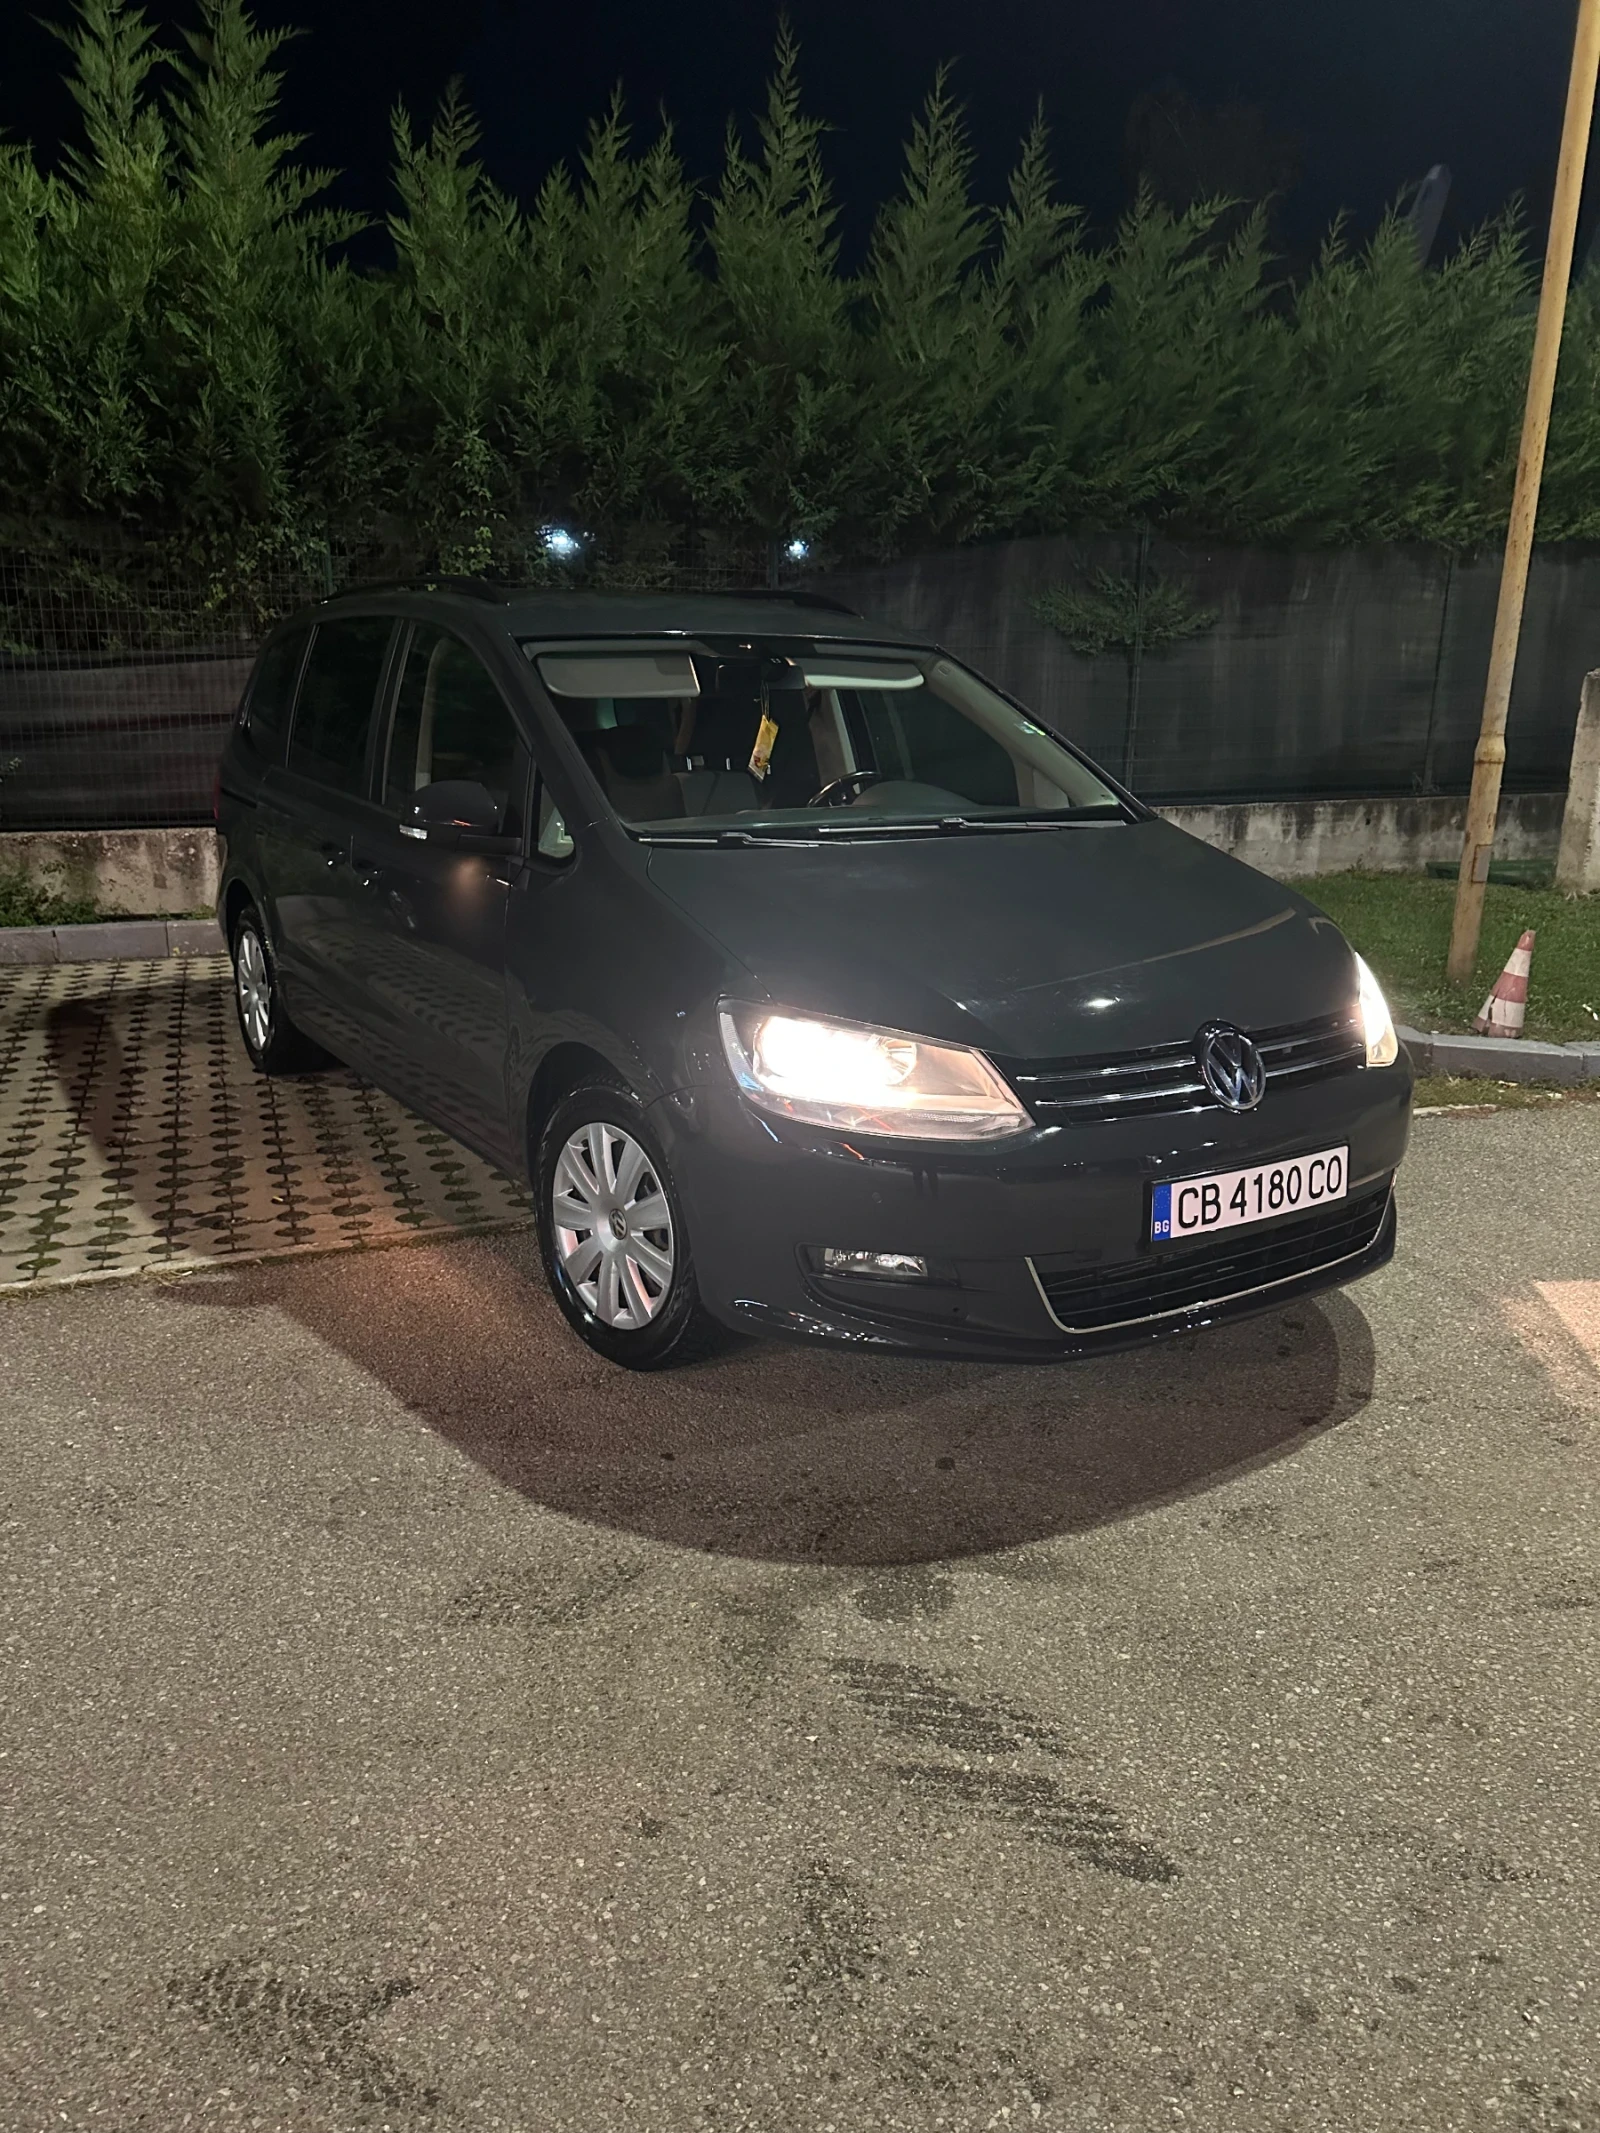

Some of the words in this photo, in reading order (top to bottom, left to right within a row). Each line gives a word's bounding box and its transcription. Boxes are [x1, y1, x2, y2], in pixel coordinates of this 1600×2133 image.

[1178, 1183, 1222, 1229] CB
[1229, 1165, 1301, 1218] 4180
[1308, 1155, 1342, 1200] CO
[1154, 1219, 1170, 1234] BG
